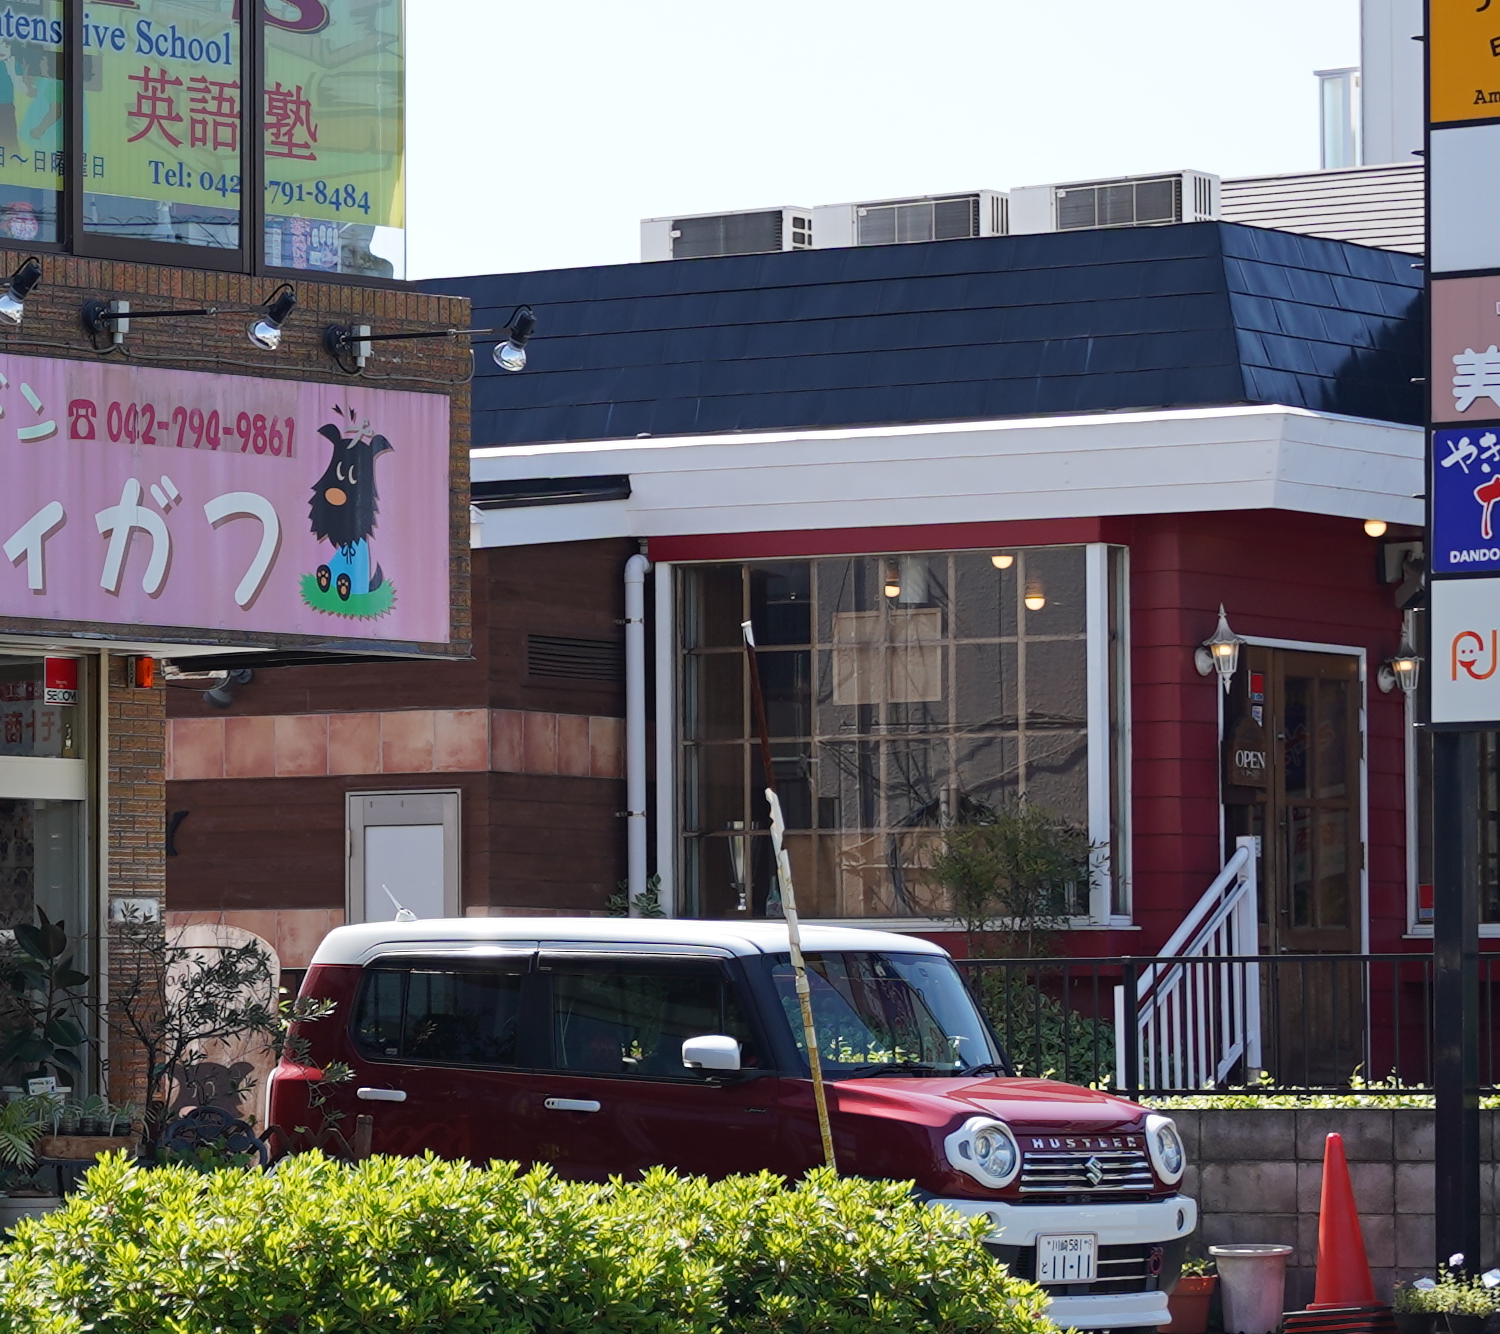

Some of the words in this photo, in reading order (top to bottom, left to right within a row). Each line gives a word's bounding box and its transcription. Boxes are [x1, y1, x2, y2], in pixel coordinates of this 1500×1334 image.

[136, 22, 232, 67] School
[127, 66, 319, 161] 英語塾
[148, 160, 192, 189] Tel:
[106, 400, 297, 457] 042-794-9861
[47, 690, 77, 701] SECOM
[1236, 749, 1266, 768] OPEN
[1031, 1137, 1137, 1149] HUSTLER
